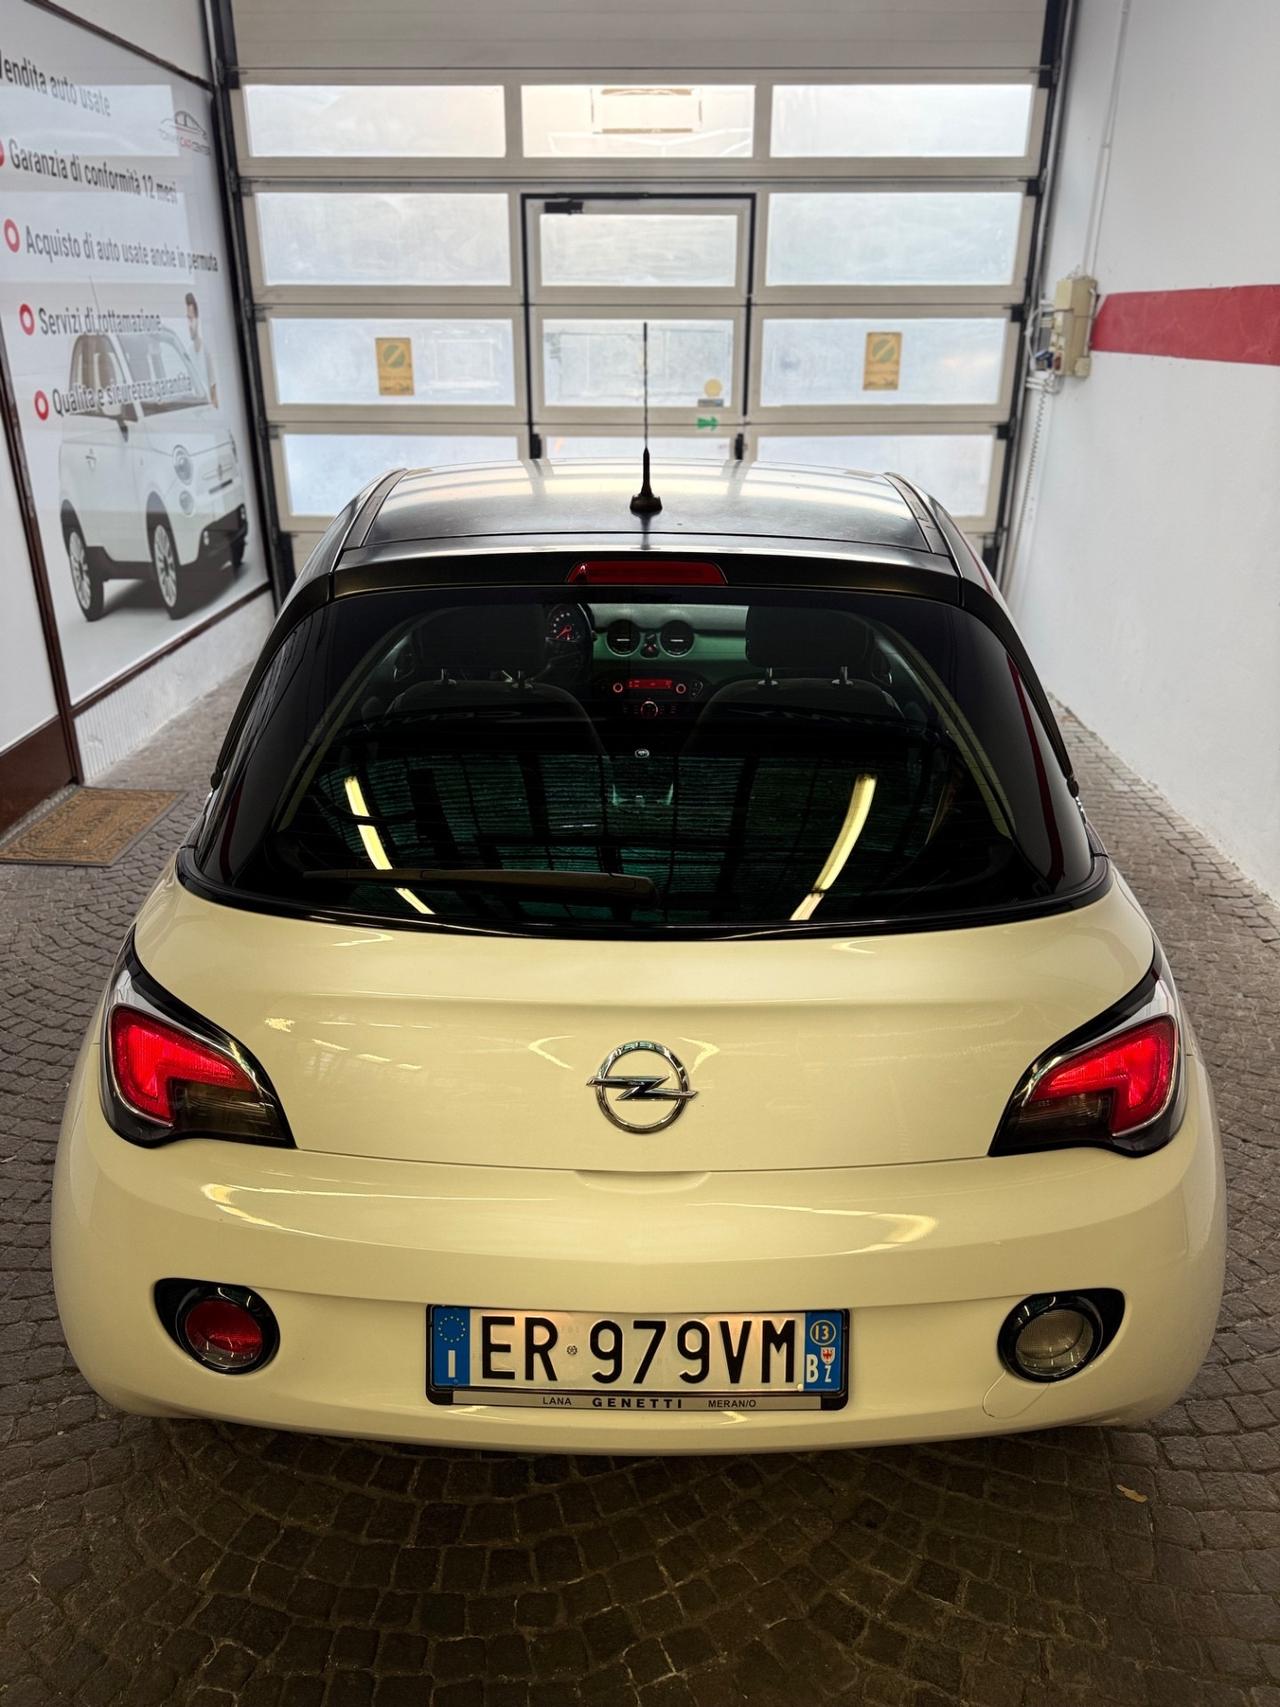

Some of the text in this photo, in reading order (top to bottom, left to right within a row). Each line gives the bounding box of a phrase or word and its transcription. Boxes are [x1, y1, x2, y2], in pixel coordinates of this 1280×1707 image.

[50, 76, 77, 105] auto
[79, 86, 111, 117] usate
[8, 138, 68, 180] Garanzia
[70, 153, 83, 184] di
[84, 161, 141, 196] conformità
[142, 174, 156, 200] 12
[25, 224, 219, 274] Acquisto di auto usate anche in permuta
[38, 306, 82, 335] Servizi
[84, 305, 96, 333] di
[97, 387, 105, 407] e
[106, 378, 154, 406] sicurezza
[482, 1315, 796, 1385] ER 979VM
[815, 1325, 830, 1341] 13
[542, 1396, 572, 1406] LANA
[592, 1397, 683, 1409] GENETTI
